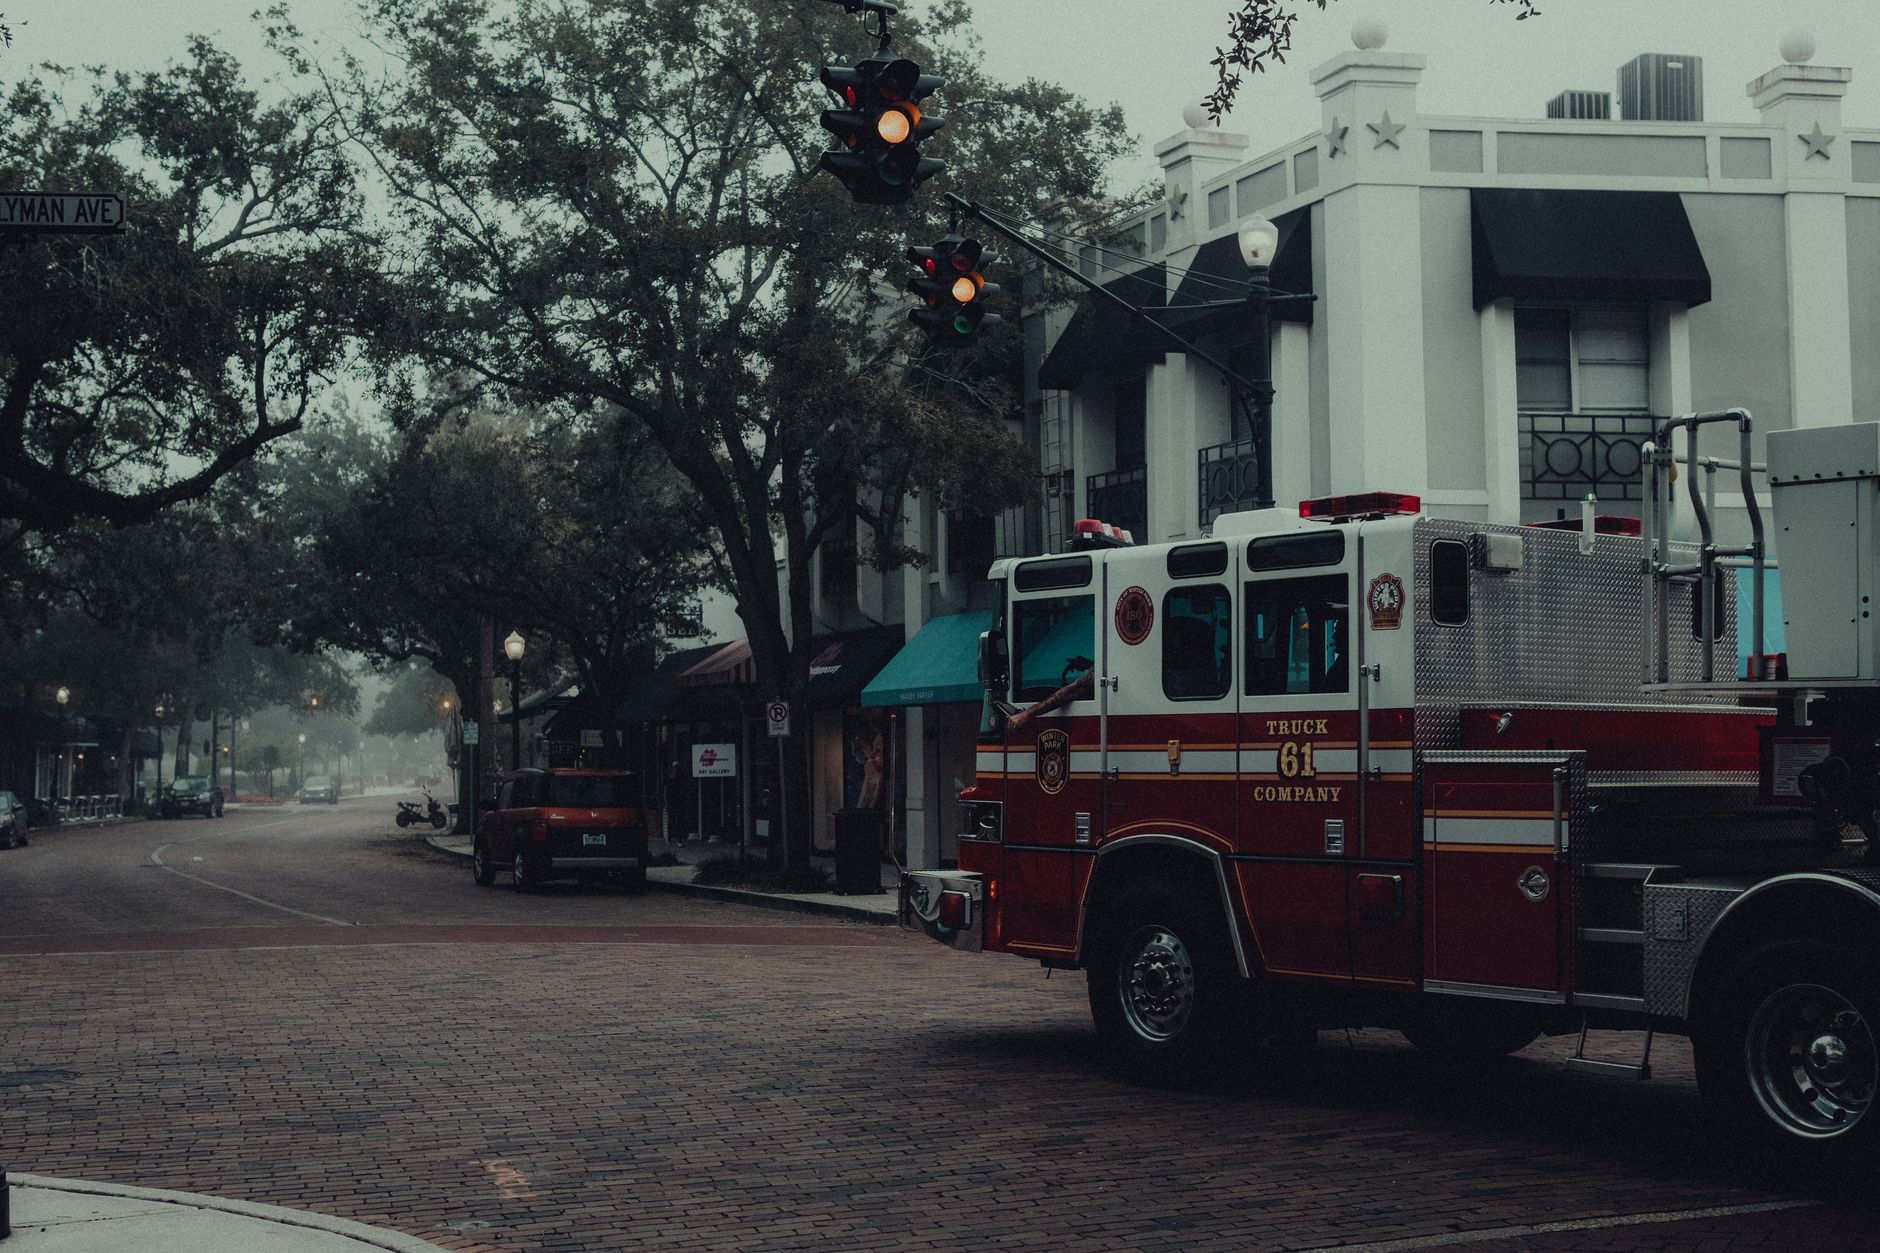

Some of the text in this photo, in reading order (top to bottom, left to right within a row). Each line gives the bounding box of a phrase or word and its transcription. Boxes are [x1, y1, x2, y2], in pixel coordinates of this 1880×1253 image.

[75, 198, 114, 224] AVE
[1266, 719, 1328, 736] TRUCK
[1041, 731, 1066, 743] WINTER
[1044, 741, 1062, 751] PARK
[1280, 741, 1315, 777] 61
[1253, 786, 1341, 802] COMPANY
